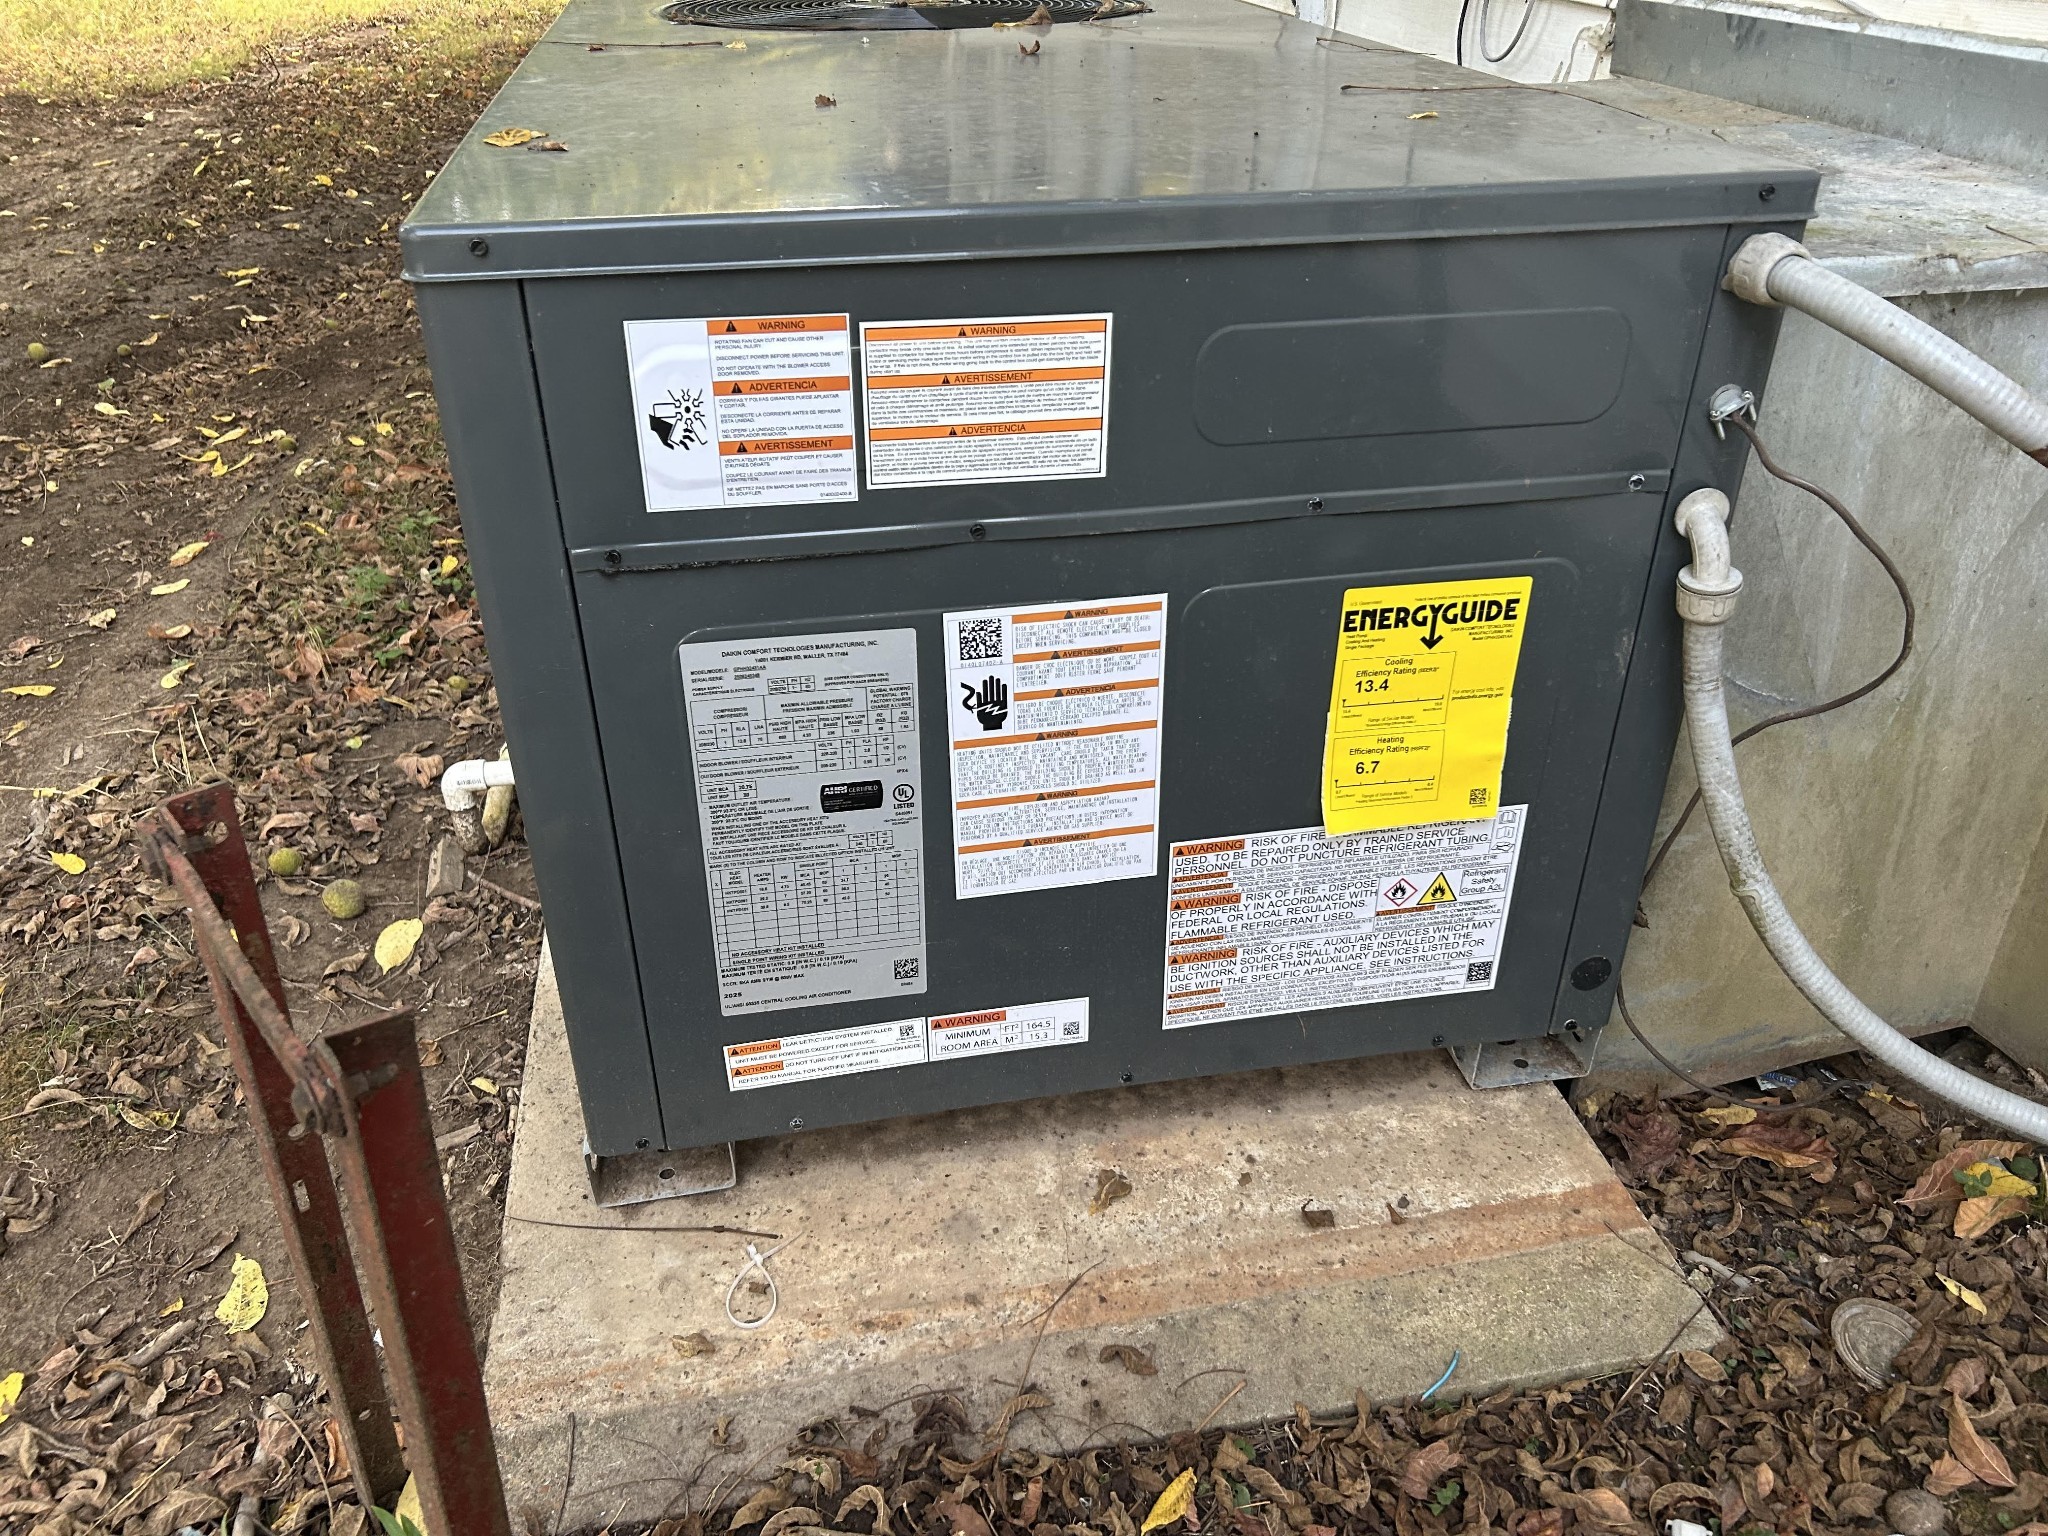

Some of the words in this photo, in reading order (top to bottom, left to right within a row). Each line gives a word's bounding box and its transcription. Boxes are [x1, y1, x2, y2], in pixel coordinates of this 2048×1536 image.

[758, 321, 805, 330] WARNING
[971, 326, 1016, 335] WARNING
[954, 372, 1032, 383] AVERTISSEMENT
[749, 381, 817, 391] ADVERTENCIA
[961, 424, 1026, 434] ADVERTENCIA
[754, 440, 833, 450] AVERTISSEMENT
[1075, 608, 1108, 616] WARNING
[1343, 598, 1520, 632] ENERGYGUIDE
[1063, 646, 1123, 658] AVERTISSEMENT
[1385, 657, 1413, 666] Cooling
[1356, 668, 1391, 678] Efficiency
[1393, 666, 1417, 676] Rating
[1066, 684, 1116, 695] ADVERTENCIA
[1355, 679, 1389, 693] 13.4
[1047, 730, 1078, 739] WARNING
[1377, 736, 1404, 744] Heating
[1349, 747, 1384, 756] Efficiency
[1387, 746, 1409, 754] Rating
[1355, 761, 1380, 774] 6.7
[849, 785, 878, 793] CERTIFIED
[898, 788, 909, 797] UL
[1047, 791, 1078, 799] WARNING
[1034, 833, 1090, 845] AVERTISSEMENT
[1216, 853, 1229, 862] TO
[1233, 851, 1247, 860] BE
[1252, 844, 1309, 858] REPAIRED
[1313, 840, 1343, 852] ONLY
[1346, 838, 1361, 848] BY
[1365, 833, 1413, 846] TRAINED
[1417, 827, 1465, 841] SERVICE
[1252, 837, 1277, 847] RISK
[1282, 835, 1296, 844] OF
[1301, 833, 1325, 842] FIRE
[1187, 840, 1242, 853] WARNING
[1251, 858, 1267, 867] DO
[1271, 855, 1294, 865] NOT
[1298, 848, 1360, 862] PUNCTURE
[1364, 839, 1442, 855] REFRIGERANT
[1464, 868, 1507, 877] Refrigerant
[1471, 877, 1496, 885] Safety
[1246, 891, 1271, 901] RISK
[1275, 889, 1290, 898] OF
[1294, 886, 1318, 896] FIRE
[1329, 880, 1377, 893] DISPOSE
[1461, 885, 1485, 894] Group
[1487, 884, 1503, 893] A2L
[1171, 910, 1186, 920] OF
[1190, 903, 1250, 917] PROPERLY
[1254, 901, 1264, 910] IN
[1268, 892, 1345, 909] ACCORDANCE
[1350, 889, 1377, 900] WITH
[1185, 895, 1239, 909] WARNING
[1172, 916, 1222, 929] FEDERAL
[1228, 913, 1243, 923] OR
[1247, 909, 1282, 921] LOCAL
[1171, 924, 1237, 939] FLAMMABLE
[1241, 915, 1317, 931] REFRIGERANT
[1243, 946, 1268, 956] RISK
[1271, 944, 1286, 952] OF
[1290, 941, 1313, 951] FIRE
[1323, 934, 1379, 947] AUXILIARY
[1383, 928, 1429, 941] DEVICES
[1433, 924, 1469, 935] WHICH
[1472, 921, 1495, 931] MAY
[1171, 965, 1184, 974] BE
[1189, 959, 1236, 971] IGNITION
[1240, 952, 1293, 966] SOURCES
[1297, 948, 1330, 959] SHALL
[1334, 946, 1354, 955] NOT
[1360, 943, 1373, 952] BE
[1377, 936, 1435, 950] INSTALLED
[1438, 935, 1448, 943] IN
[1454, 932, 1472, 941] THE
[1182, 950, 1235, 963] WARNING
[1241, 963, 1278, 974] OTHER
[1283, 959, 1310, 970] THAN
[1314, 952, 1369, 966] AUXILIARY
[1373, 947, 1419, 959] DEVICES
[1422, 942, 1459, 954] LISTED
[1462, 939, 1484, 949] FOR
[1170, 982, 1191, 992] USE
[1195, 978, 1223, 989] WITH
[1228, 975, 1247, 985] THE
[1251, 970, 1300, 983] SPECIFIC
[1370, 960, 1390, 969] SEE
[818, 990, 851, 998] CONDITIONER
[946, 1013, 1000, 1026] WARNING
[1027, 1021, 1051, 1029] 164.5
[945, 1029, 990, 1040] MINIMUM
[1031, 1032, 1048, 1040] 15.3
[740, 1043, 778, 1054] ATTENTION
[941, 1043, 970, 1052] ROOM
[974, 1040, 998, 1048] AREA
[743, 1063, 781, 1074] ATTENTION
